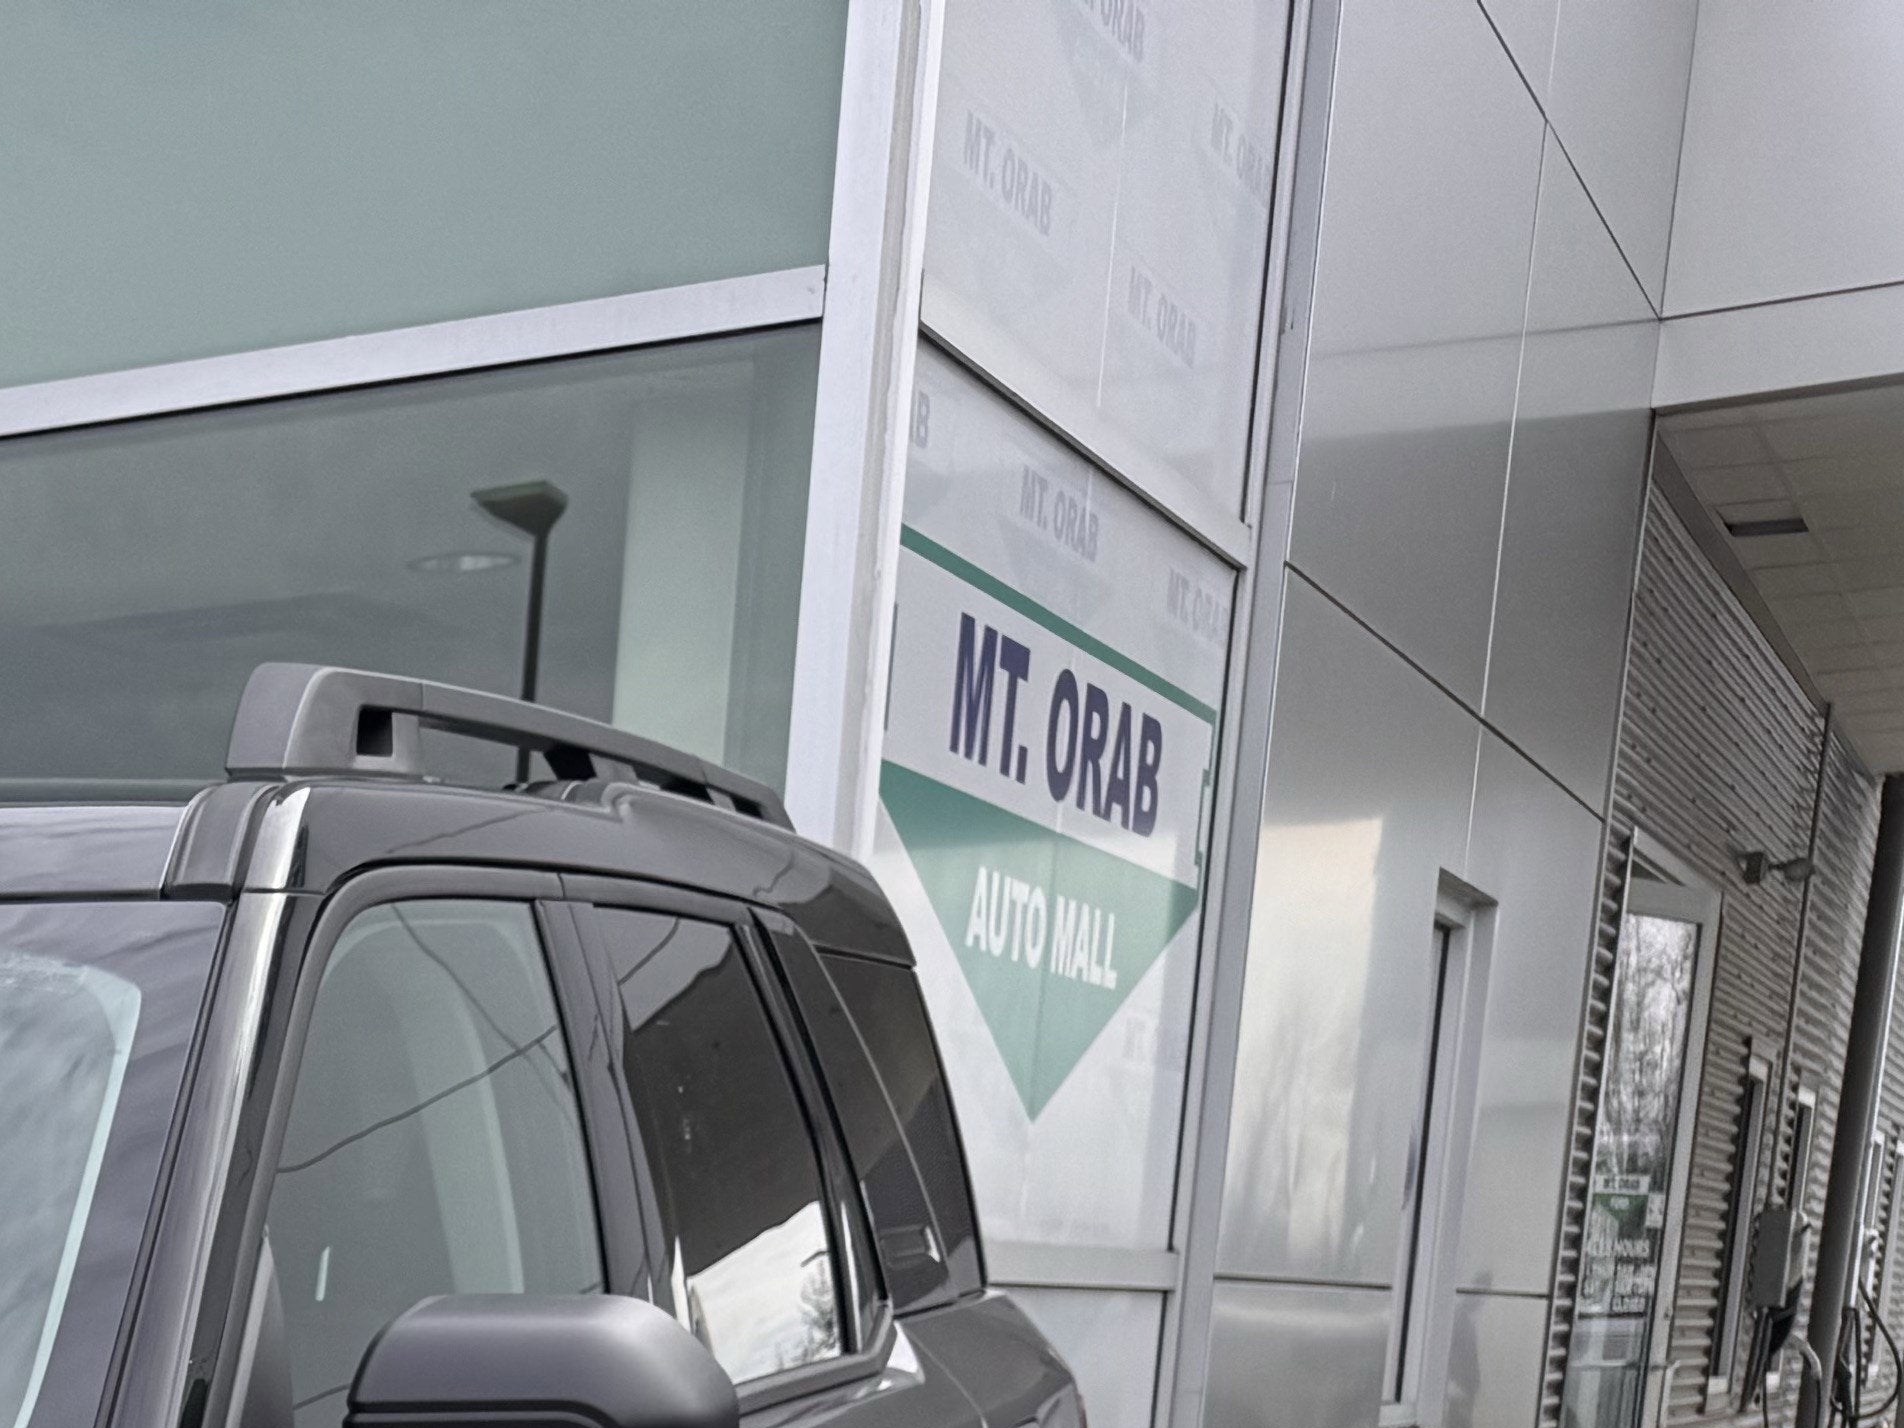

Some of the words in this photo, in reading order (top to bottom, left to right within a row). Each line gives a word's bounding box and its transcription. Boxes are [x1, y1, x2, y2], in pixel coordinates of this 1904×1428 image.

[1001, 147, 1052, 237] ORAB
[1053, 490, 1099, 563] ORAB
[949, 612, 1030, 786] MT.
[1045, 667, 1163, 838] ORAB
[965, 866, 1048, 969] AUTO
[1050, 894, 1118, 990] MALL
